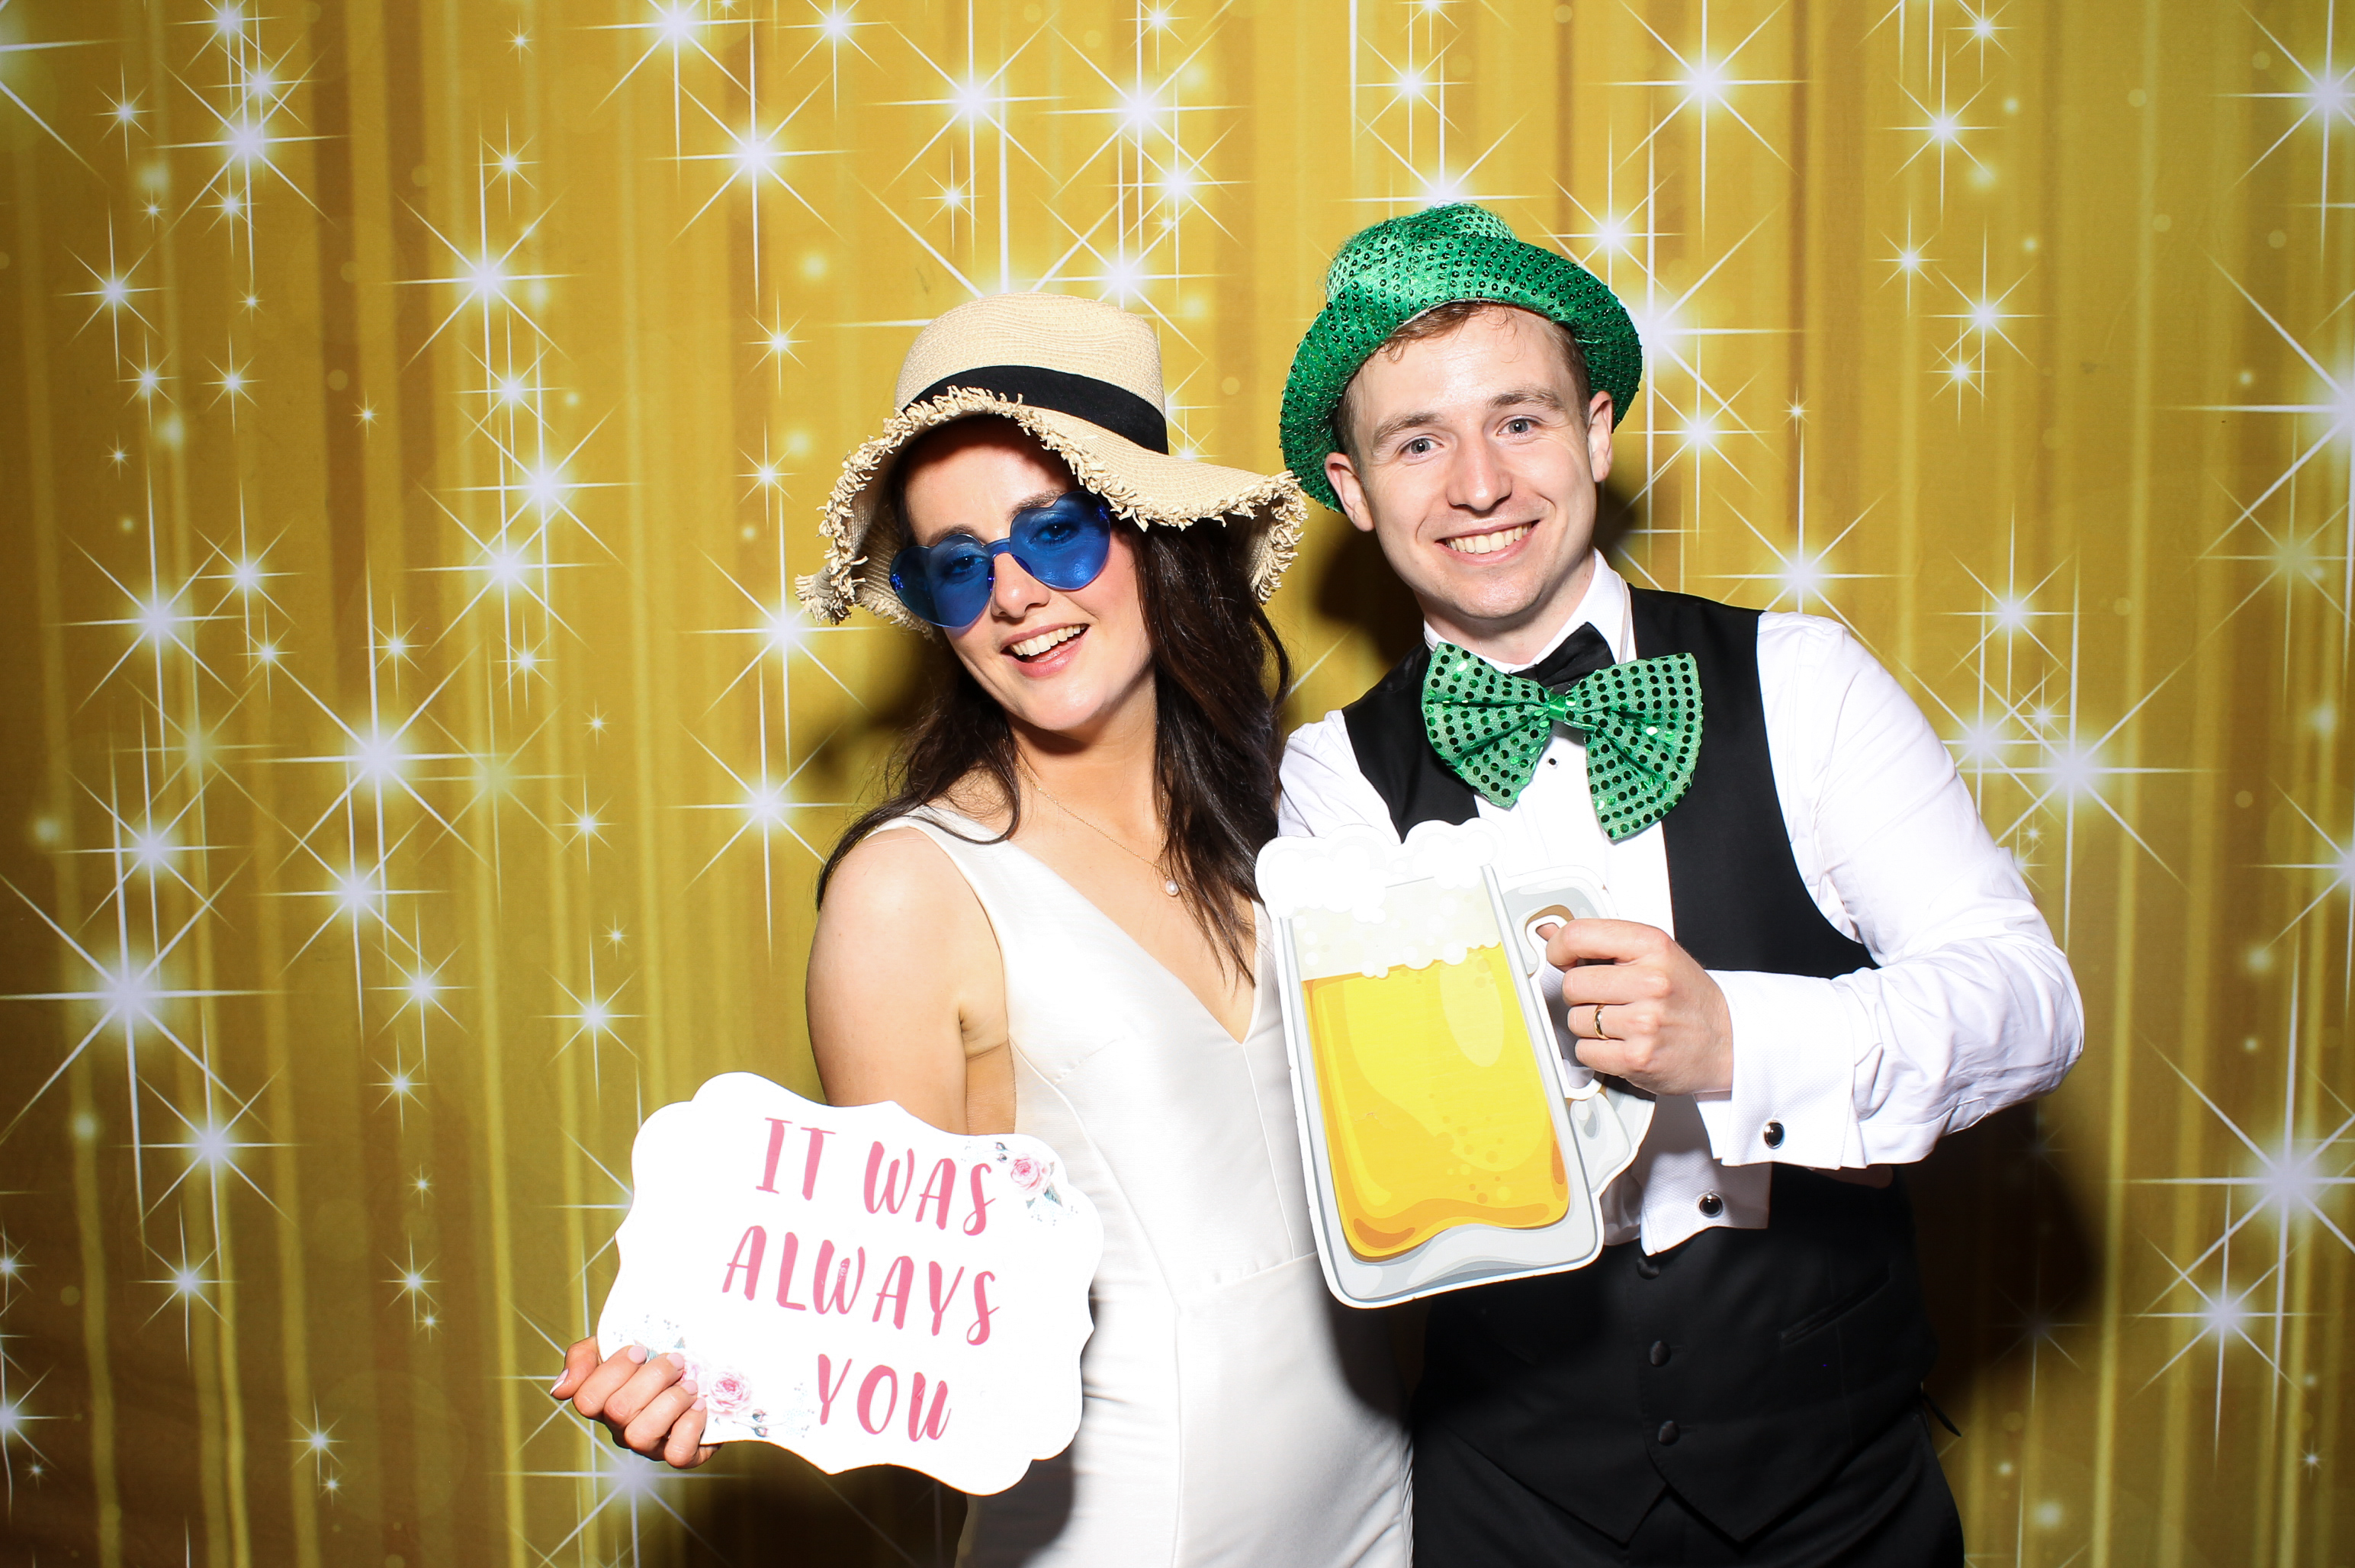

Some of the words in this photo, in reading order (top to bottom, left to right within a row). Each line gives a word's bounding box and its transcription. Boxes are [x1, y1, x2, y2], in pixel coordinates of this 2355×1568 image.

[756, 1117, 837, 1200] IT
[864, 1140, 996, 1236] WAS
[722, 1225, 1000, 1346] ALWAYS
[818, 1353, 952, 1443] YOU
